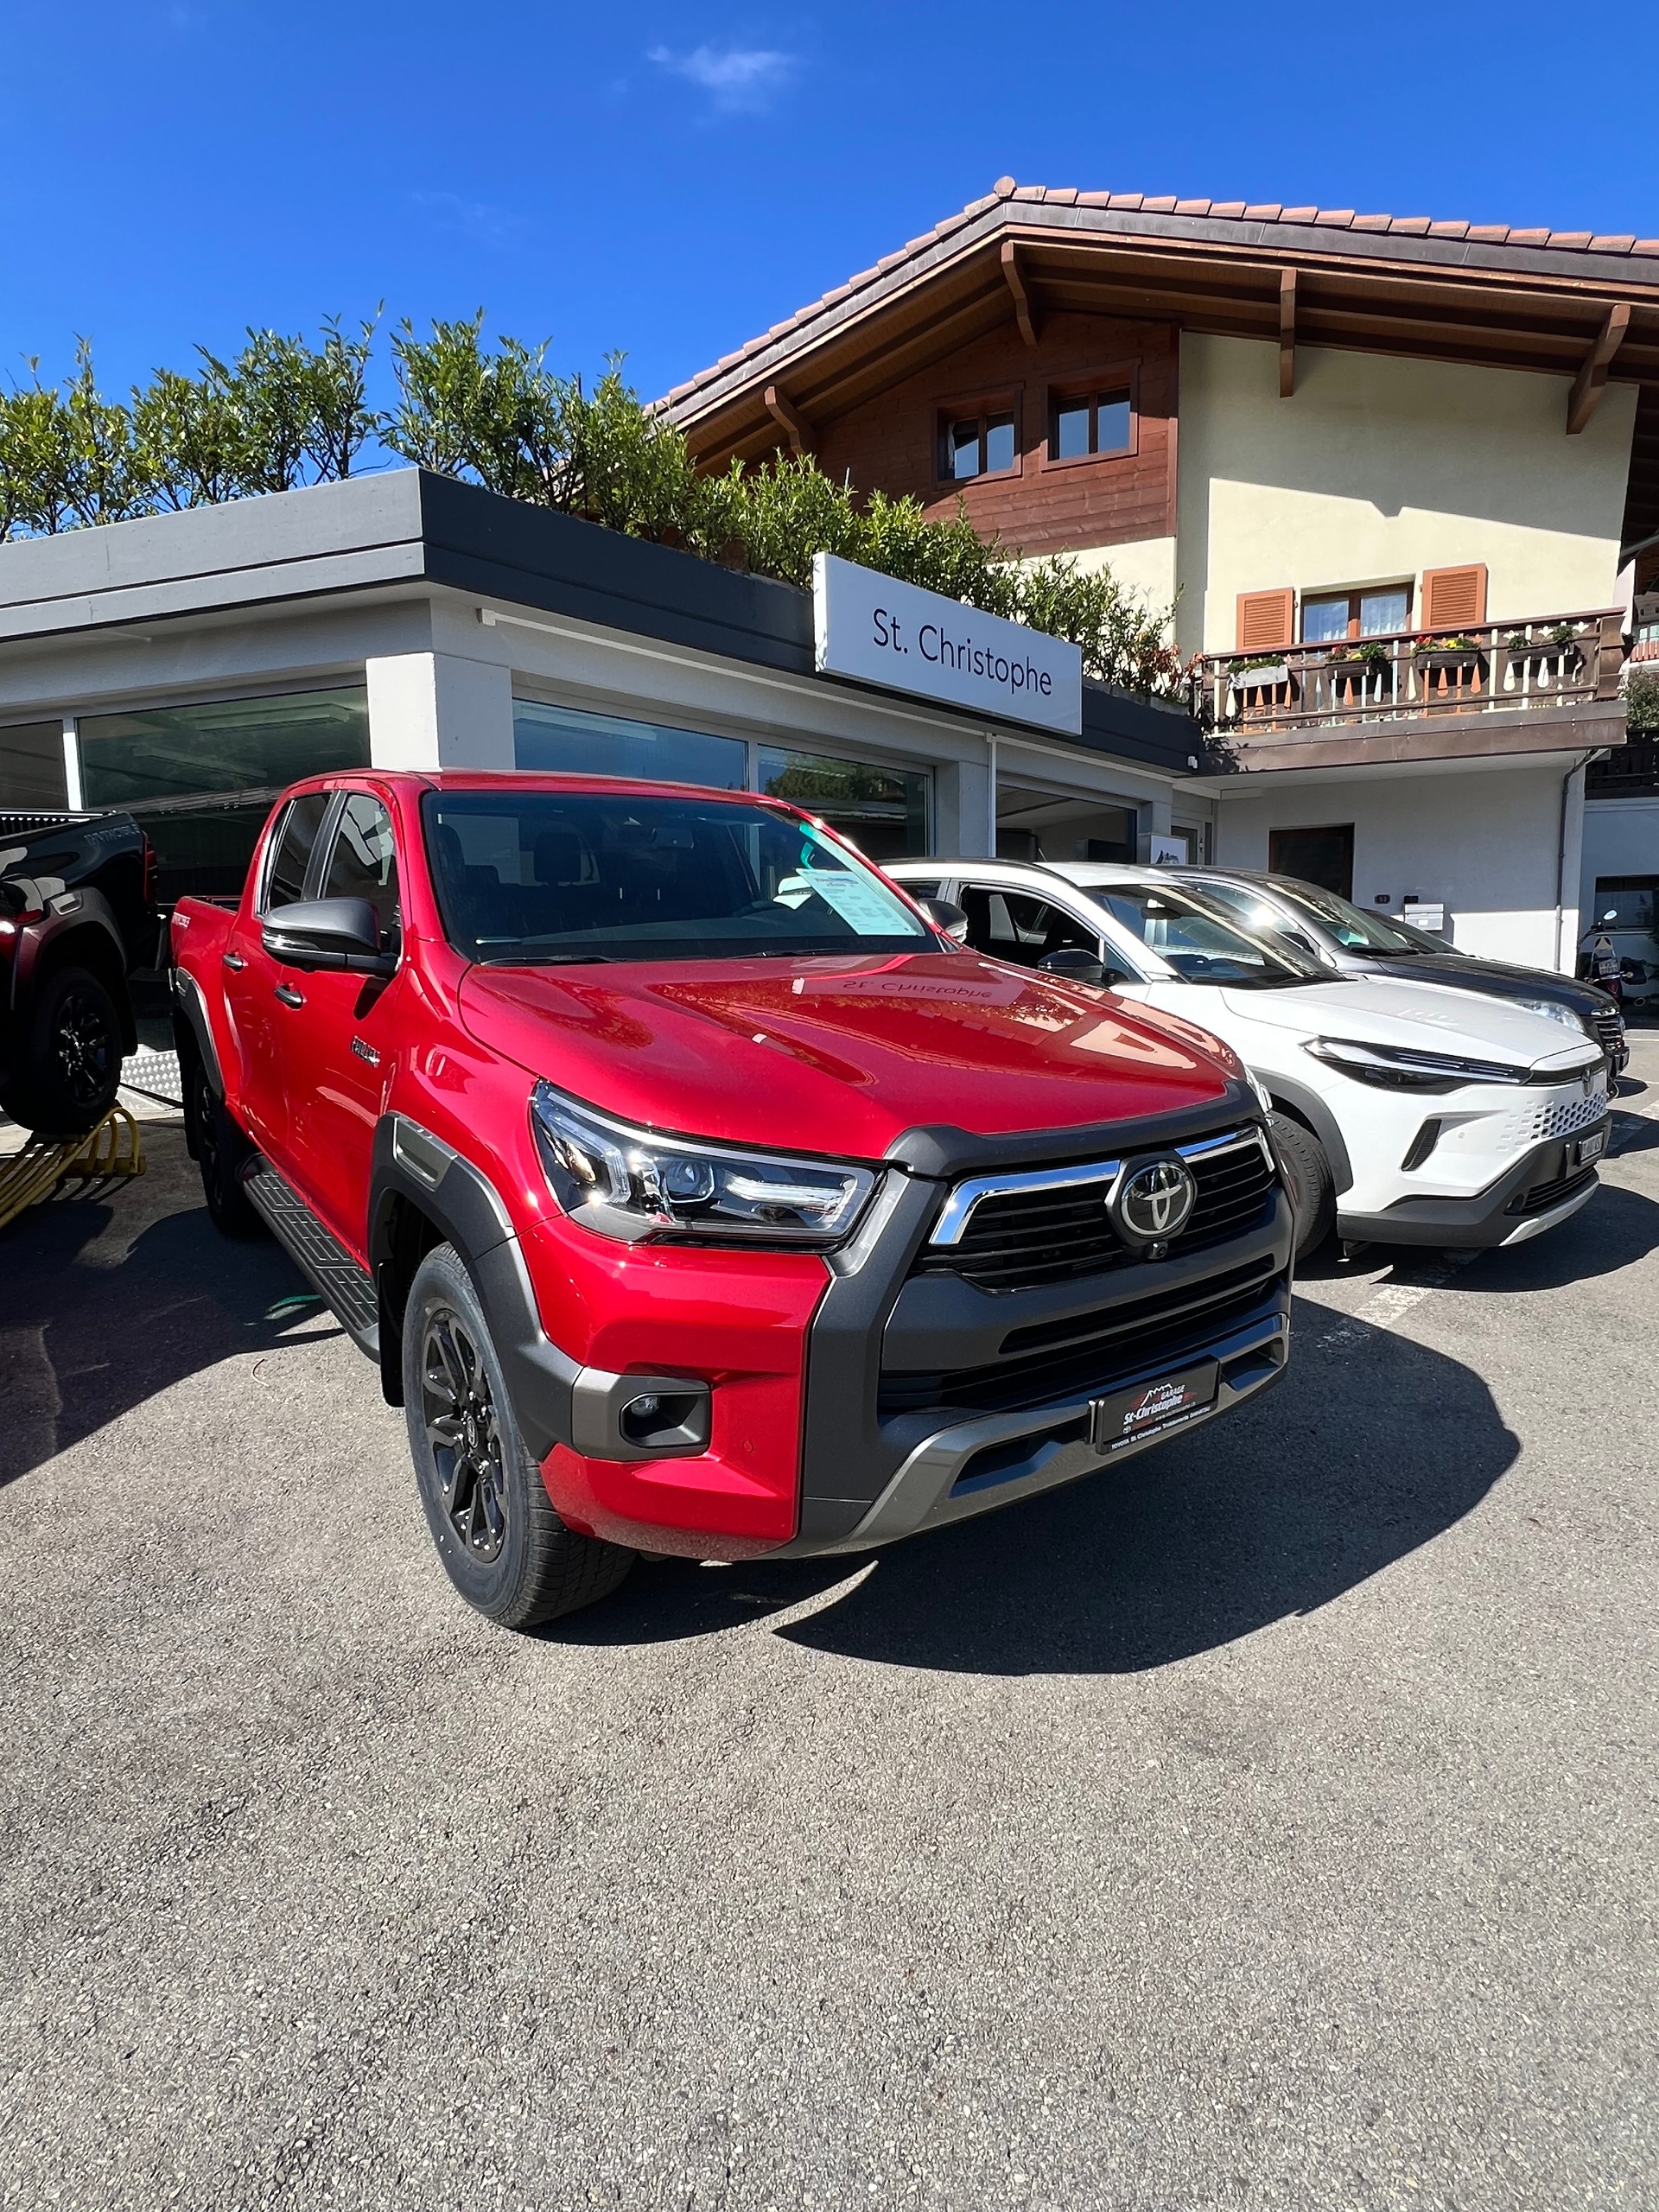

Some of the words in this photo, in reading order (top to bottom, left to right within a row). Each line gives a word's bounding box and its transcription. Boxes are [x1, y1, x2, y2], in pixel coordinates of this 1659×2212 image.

[873, 607, 908, 654] St.
[918, 624, 1052, 695] Christophe
[1160, 1384, 1185, 1401] GARAGE
[1123, 1394, 1183, 1426] St-Christophe
